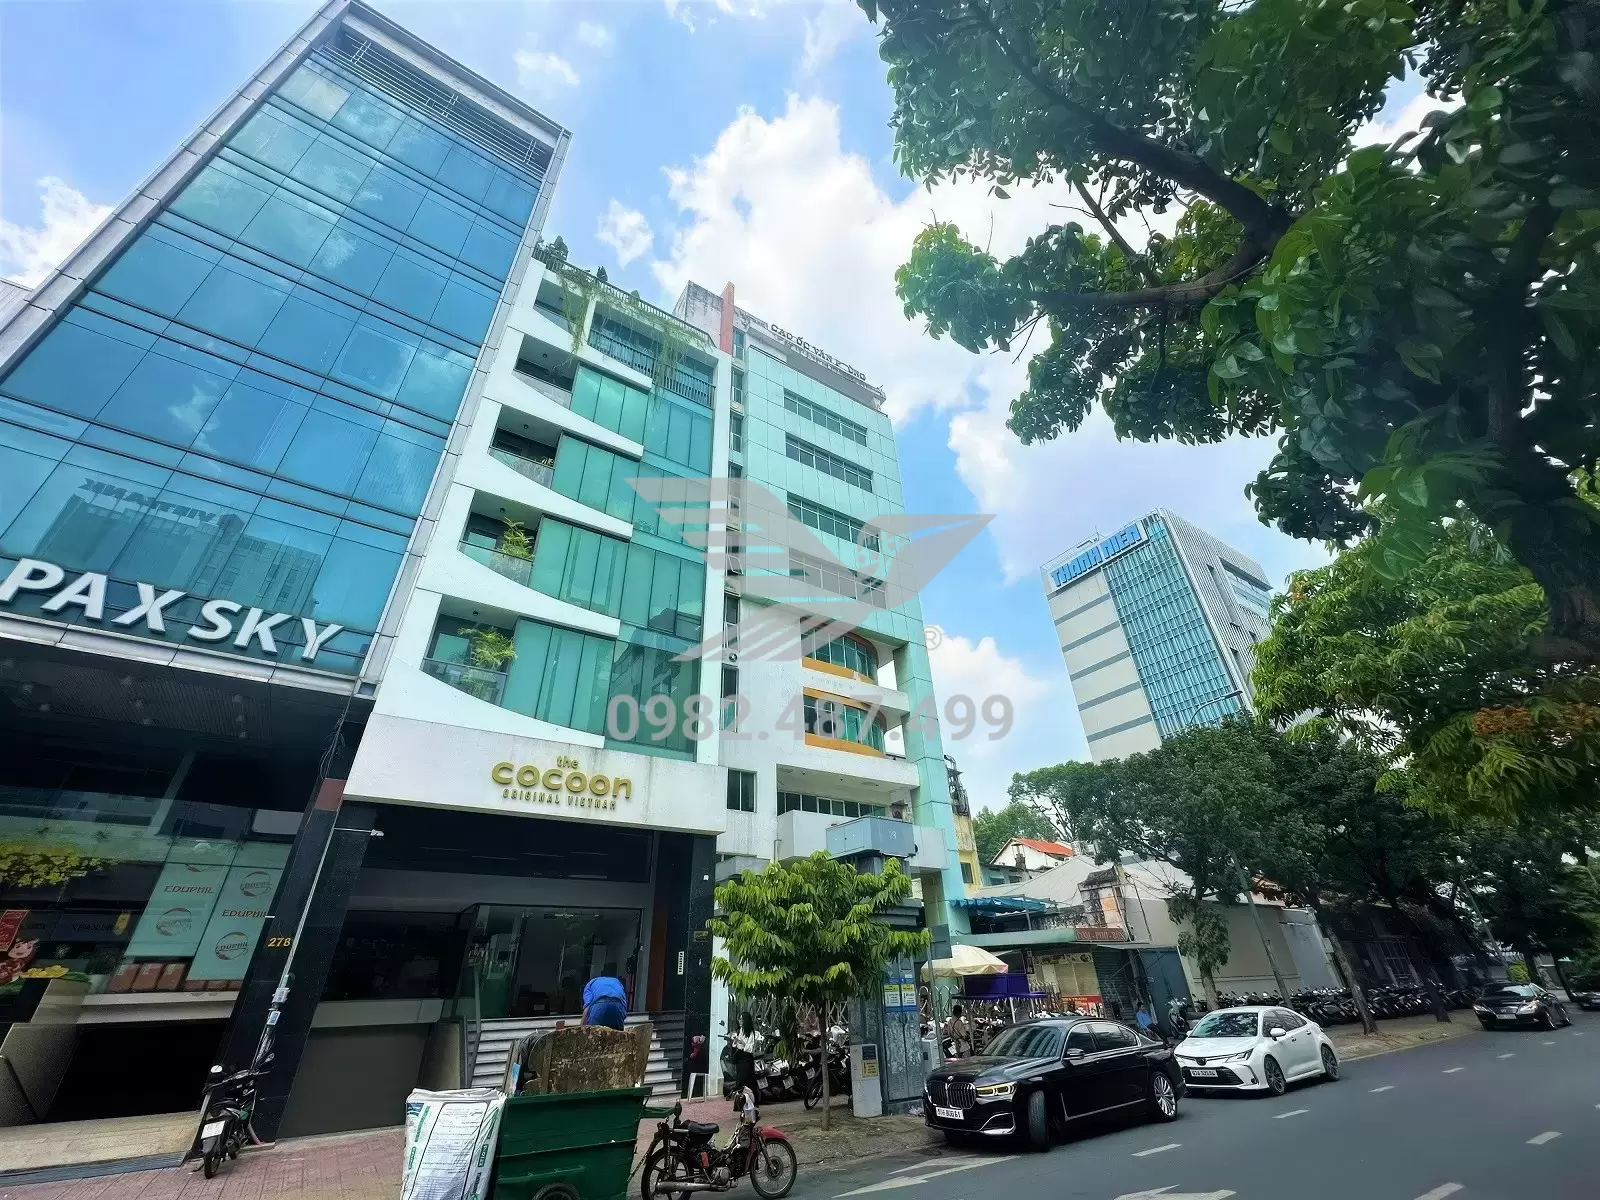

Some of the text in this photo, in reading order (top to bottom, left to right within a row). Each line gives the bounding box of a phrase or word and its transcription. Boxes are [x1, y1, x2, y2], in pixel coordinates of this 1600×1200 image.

[771, 324, 793, 340] CAO
[1051, 545, 1103, 587] THANH
[0, 558, 345, 660] PAX SKY
[556, 755, 579, 770] the
[491, 762, 632, 799] cocoon
[502, 788, 617, 810] ORIGINAL VIETNAM
[163, 885, 214, 894] EDUPHIL
[221, 909, 268, 918] EDUPHIL
